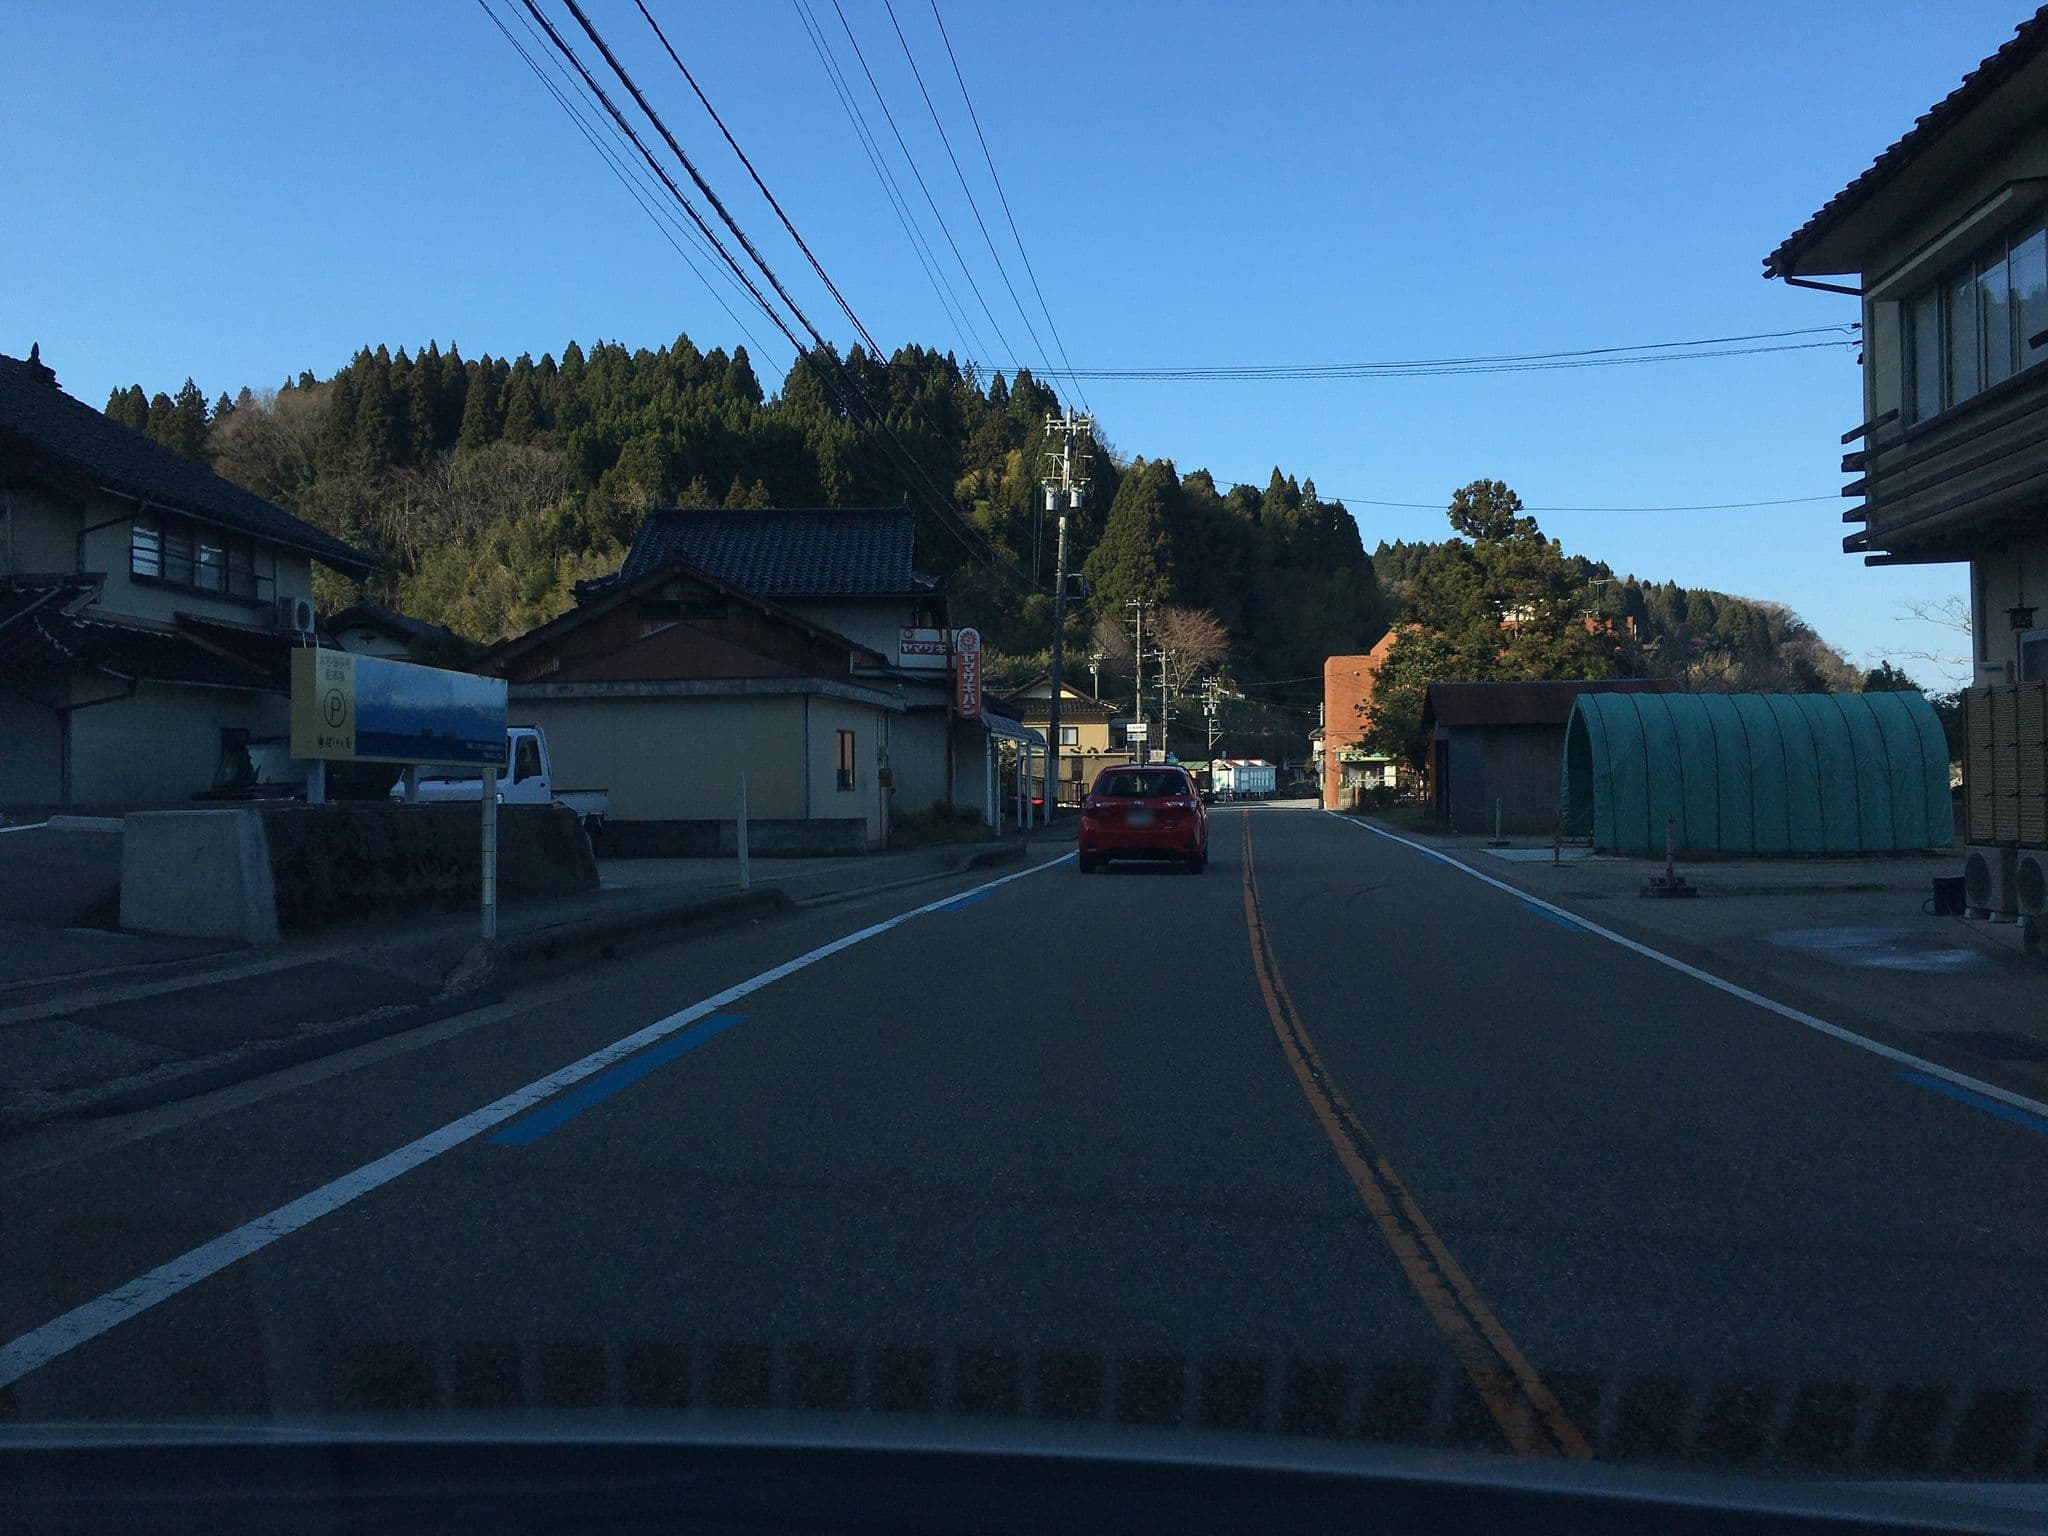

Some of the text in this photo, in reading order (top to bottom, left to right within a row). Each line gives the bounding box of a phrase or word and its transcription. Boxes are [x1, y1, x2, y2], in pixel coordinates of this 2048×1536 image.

[962, 652, 976, 715] ヤマザキパン
[331, 696, 341, 721] P
